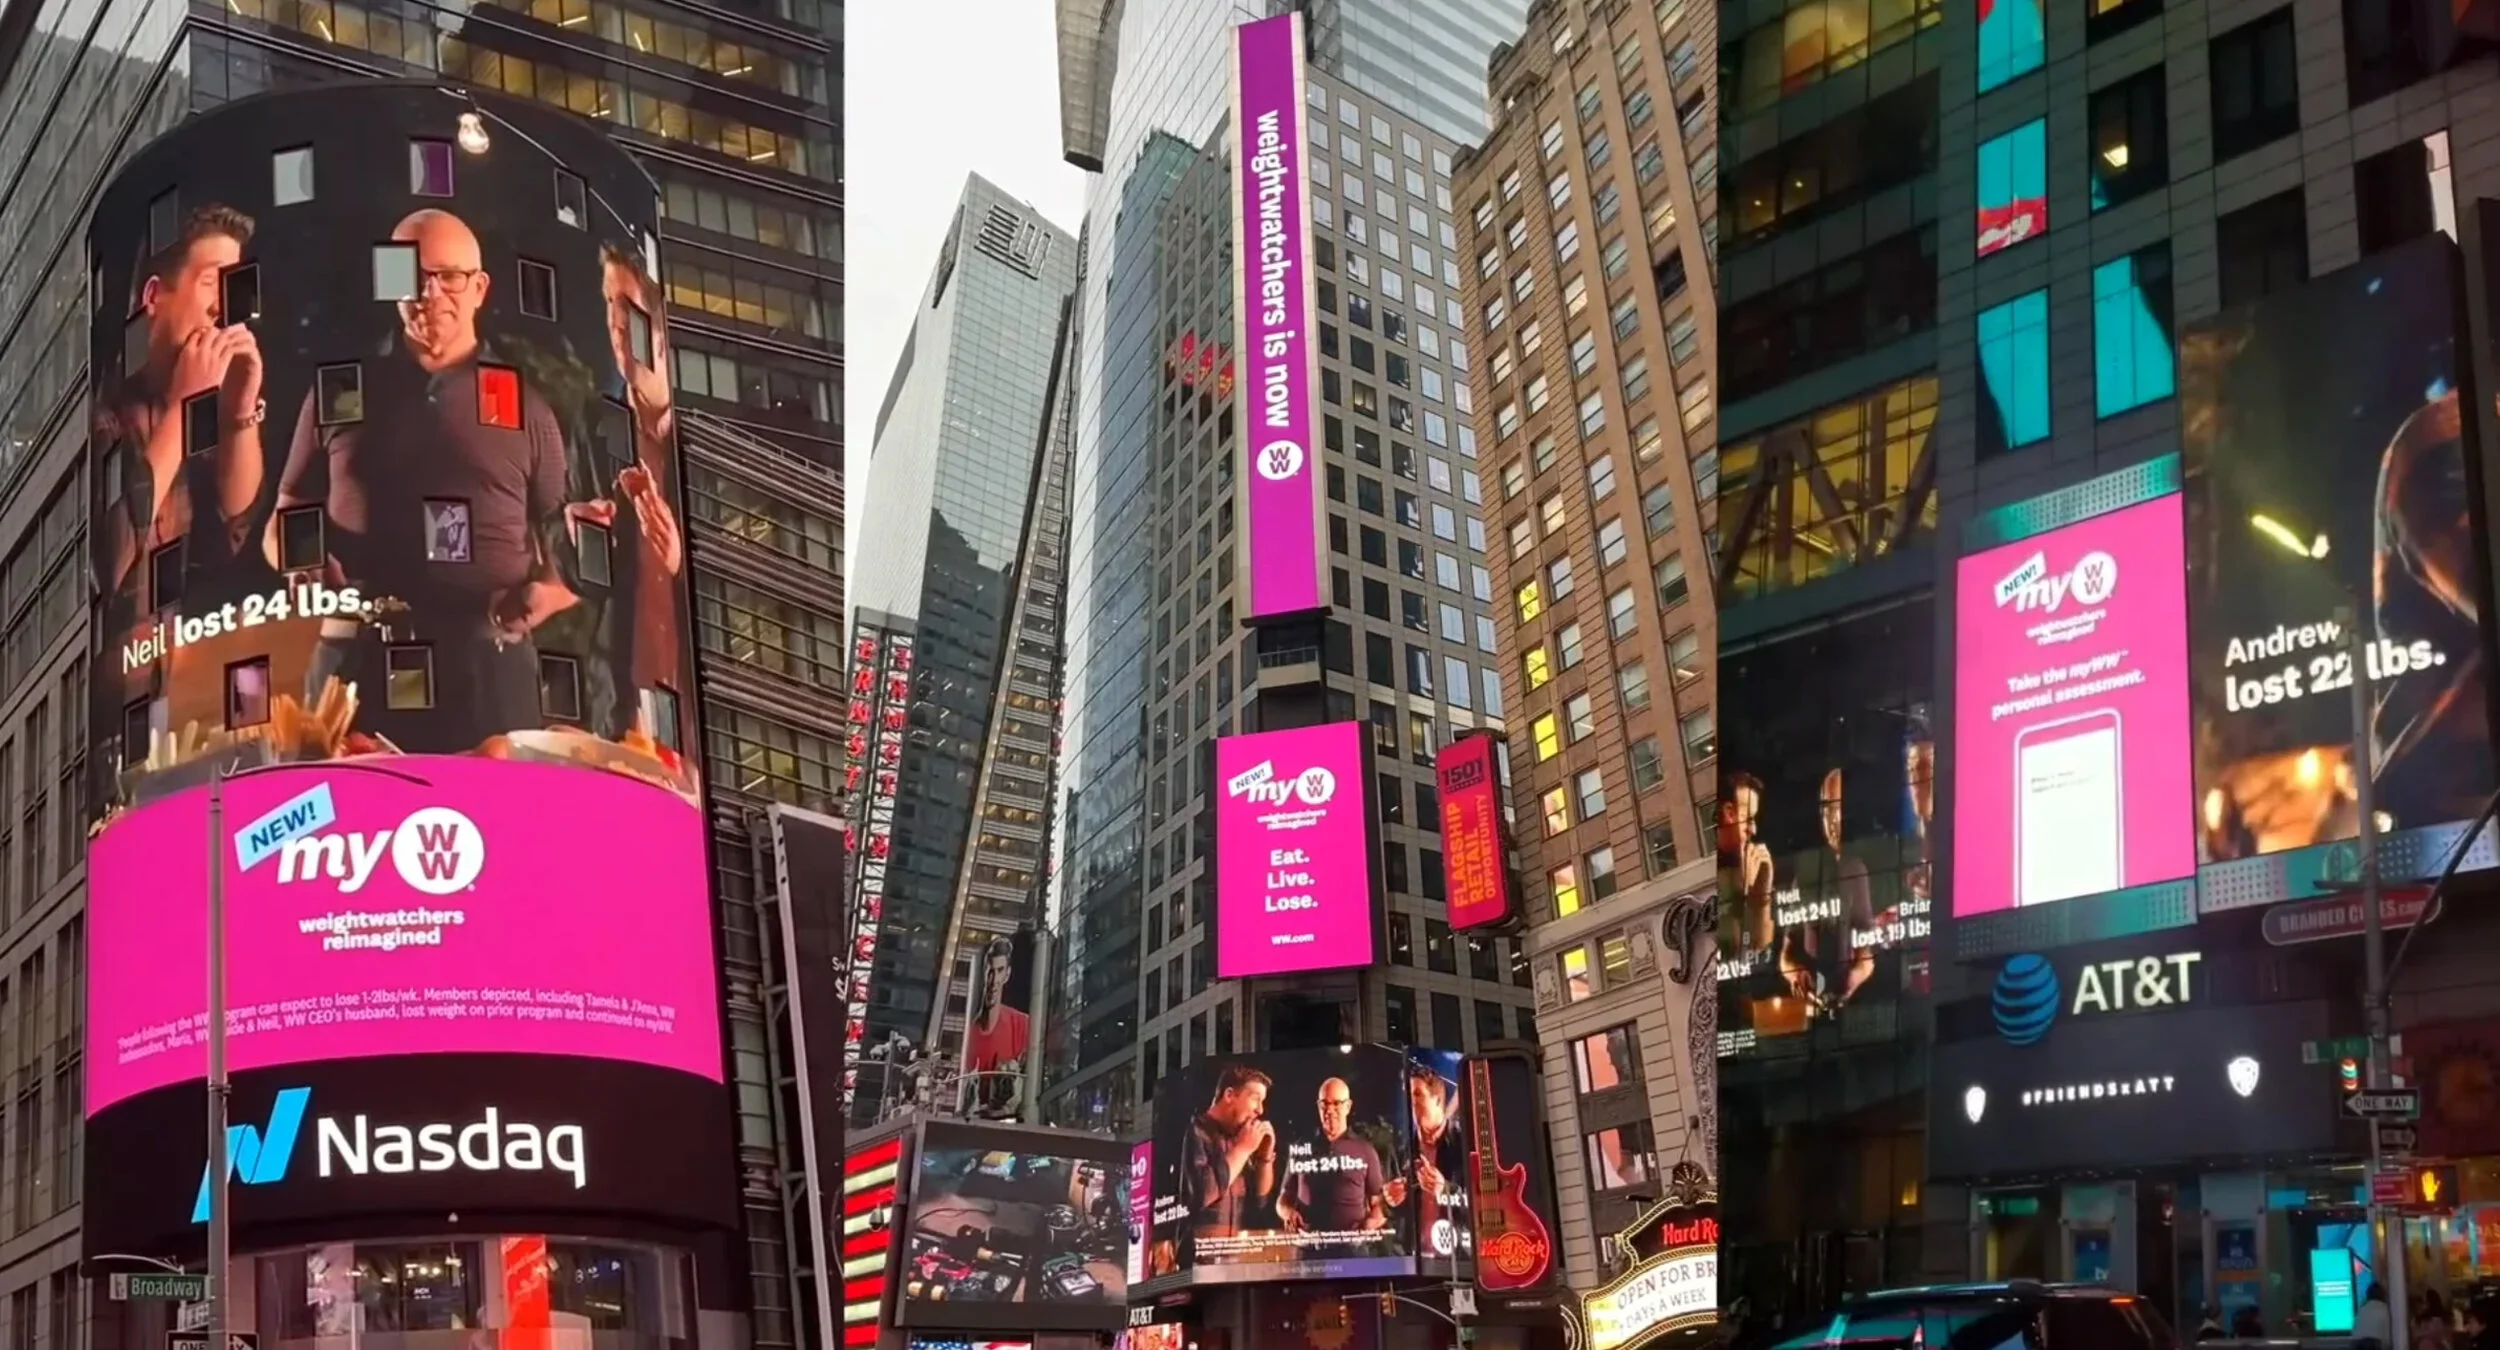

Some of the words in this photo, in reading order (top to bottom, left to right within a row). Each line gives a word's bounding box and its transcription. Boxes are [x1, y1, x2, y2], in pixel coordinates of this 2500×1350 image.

[1251, 109, 1292, 326] weightwatchers
[1264, 331, 1295, 359] is
[1265, 364, 1290, 427] now
[2004, 564, 2037, 596] NEW!
[2016, 572, 2072, 613] my
[123, 624, 166, 674] Neil
[174, 602, 236, 647] lost
[243, 589, 290, 627] 24
[297, 583, 373, 617] lbs.
[2224, 620, 2341, 667] Andrew
[2008, 673, 2042, 693] Take
[2043, 668, 2067, 686] the
[2225, 666, 2303, 712] lost
[2309, 651, 2354, 694] 22
[2365, 638, 2447, 680] lbs.
[1992, 689, 2053, 721] personal
[2055, 668, 2146, 703] assessment.
[1236, 768, 1266, 790] NEW!
[1441, 757, 1484, 786] 1501
[1247, 777, 1297, 806] my
[250, 802, 317, 853] NEW!
[1270, 849, 1310, 867] Eat.
[1447, 802, 1469, 909] FLAGSHIP
[1475, 795, 1497, 898] OPPORTUNITY
[277, 830, 394, 893] my
[1465, 827, 1485, 904] RETAIL
[1267, 871, 1315, 889] Live.
[1265, 894, 1319, 912] Lose.
[1777, 888, 1800, 904] Neil
[299, 907, 465, 933] weightwatchers
[1778, 907, 1808, 927] lost
[1810, 901, 1829, 921] 24
[2280, 905, 2346, 934] BRANDED
[323, 928, 441, 951] reimagined
[1272, 933, 1315, 945] WW.com
[1852, 927, 1884, 948] lost
[1886, 924, 1905, 943] 19
[2073, 952, 2202, 1015] AT&T
[258, 1003, 279, 1015] can
[280, 997, 318, 1012] expect
[320, 996, 333, 1007] to
[335, 992, 360, 1005] lose
[362, 987, 422, 1004] 1-2lbs/wk.
[424, 987, 479, 1001] Members
[480, 986, 534, 1004] depicted,
[535, 989, 584, 1009] including
[246, 1019, 255, 1033] &
[257, 1014, 282, 1031] Neil,
[284, 1013, 307, 1027] WW
[308, 1009, 342, 1024] CEO's
[344, 1005, 399, 1021] husband,
[401, 1003, 425, 1017] lost
[427, 1003, 468, 1020] weight
[468, 1006, 486, 1017] on
[487, 1002, 515, 1019] prior
[516, 1006, 563, 1020] program
[565, 1006, 584, 1020] and
[2355, 1095, 2379, 1110] ONE
[2385, 1094, 2409, 1110] WAY
[317, 1107, 586, 1190] Nasdaq
[1289, 1143, 1312, 1156] Neil
[1289, 1158, 1318, 1173] lost
[1320, 1157, 1339, 1172] 24
[1340, 1155, 1368, 1171] lbs.
[1436, 1191, 1462, 1207] lost
[1661, 1220, 1699, 1246] Hard
[1480, 1238, 1514, 1257] Hard
[1514, 1239, 1546, 1258] Rock
[131, 1277, 203, 1301] Broadway
[1617, 1275, 1656, 1310] OPEN
[1660, 1264, 1691, 1288] FOR
[1659, 1298, 1668, 1313] A
[1669, 1287, 1707, 1308] WEEK
[1129, 1305, 1155, 1327] AT&T
